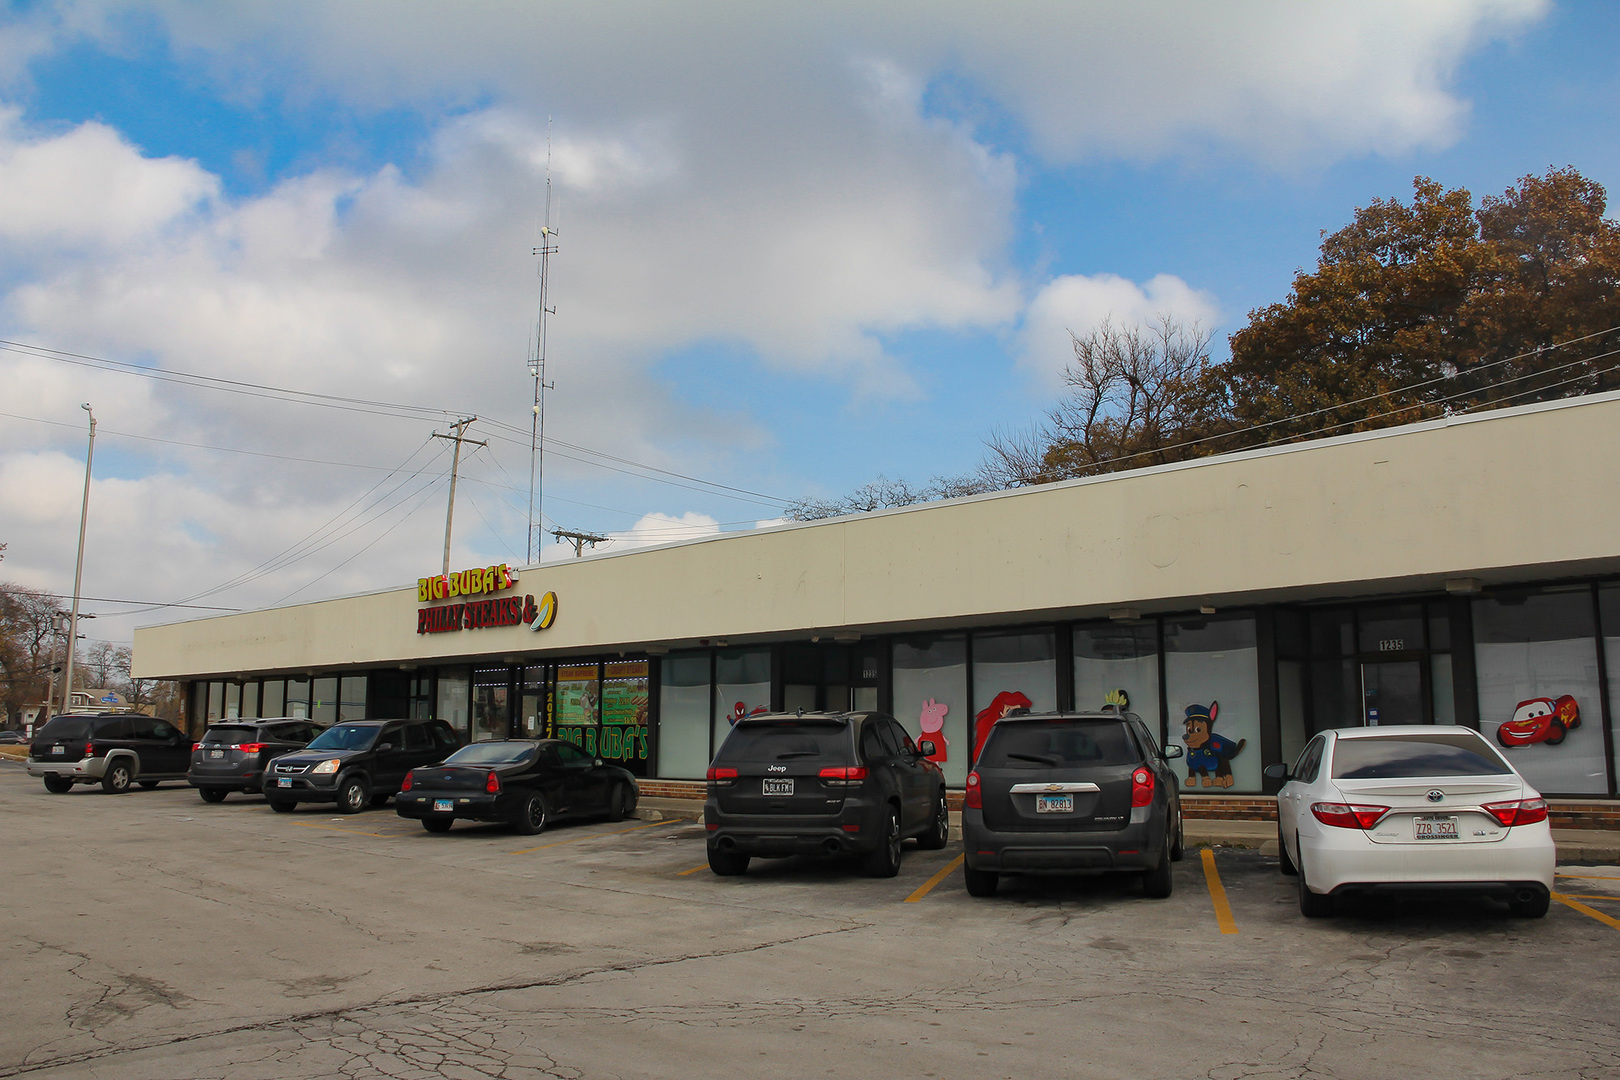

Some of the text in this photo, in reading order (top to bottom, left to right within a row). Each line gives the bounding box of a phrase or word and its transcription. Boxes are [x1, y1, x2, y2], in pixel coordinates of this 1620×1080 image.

[417, 563, 513, 603] BIG BUBA'S
[416, 605, 464, 635] PHILLY
[463, 595, 524, 629] STEAKS
[1379, 640, 1404, 651] 1235
[557, 724, 649, 763] BIG BUBA'S
[767, 764, 788, 774] Jeep
[1050, 799, 1072, 809] 82813
[1416, 822, 1457, 835] ZZ8 3521
